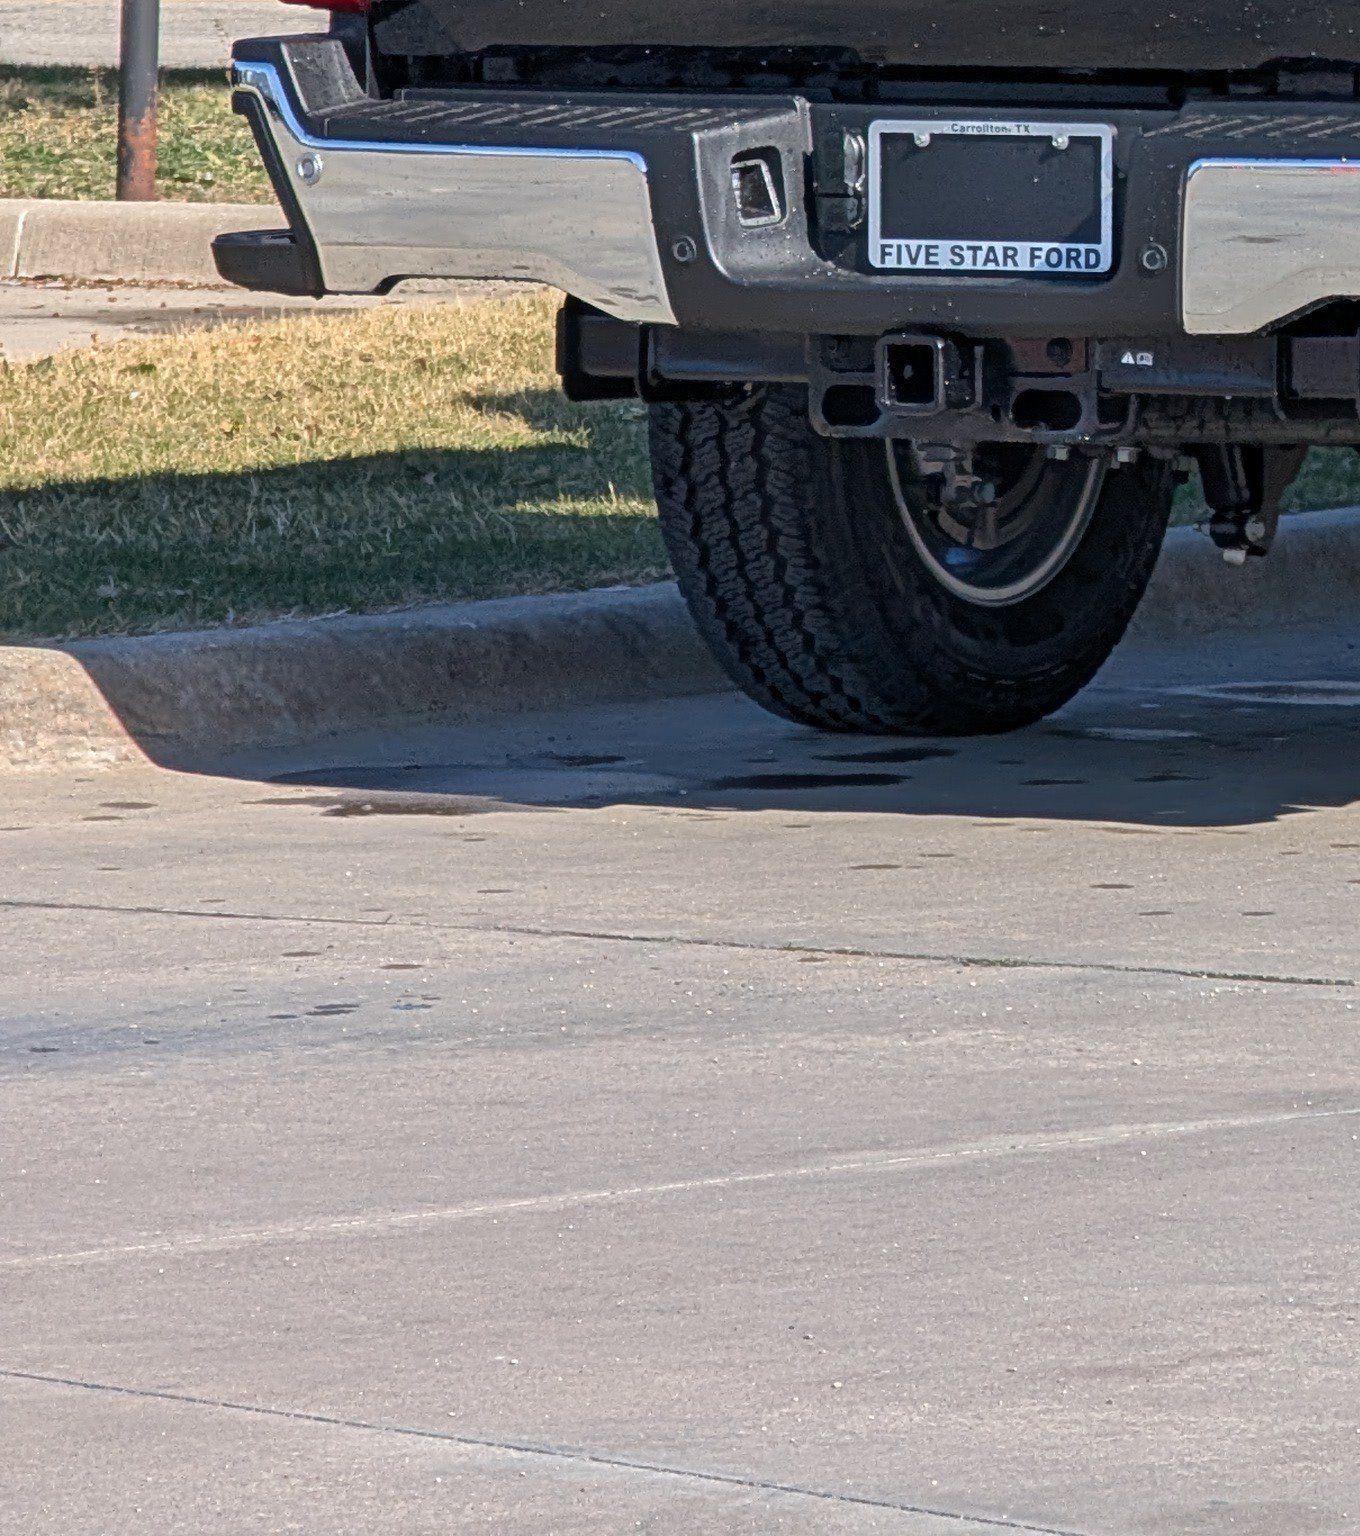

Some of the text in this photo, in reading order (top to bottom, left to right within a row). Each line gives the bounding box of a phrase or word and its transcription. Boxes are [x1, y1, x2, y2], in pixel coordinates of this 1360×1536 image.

[1014, 123, 1031, 135] TX
[879, 243, 1102, 270] FIVE STAR FORD
